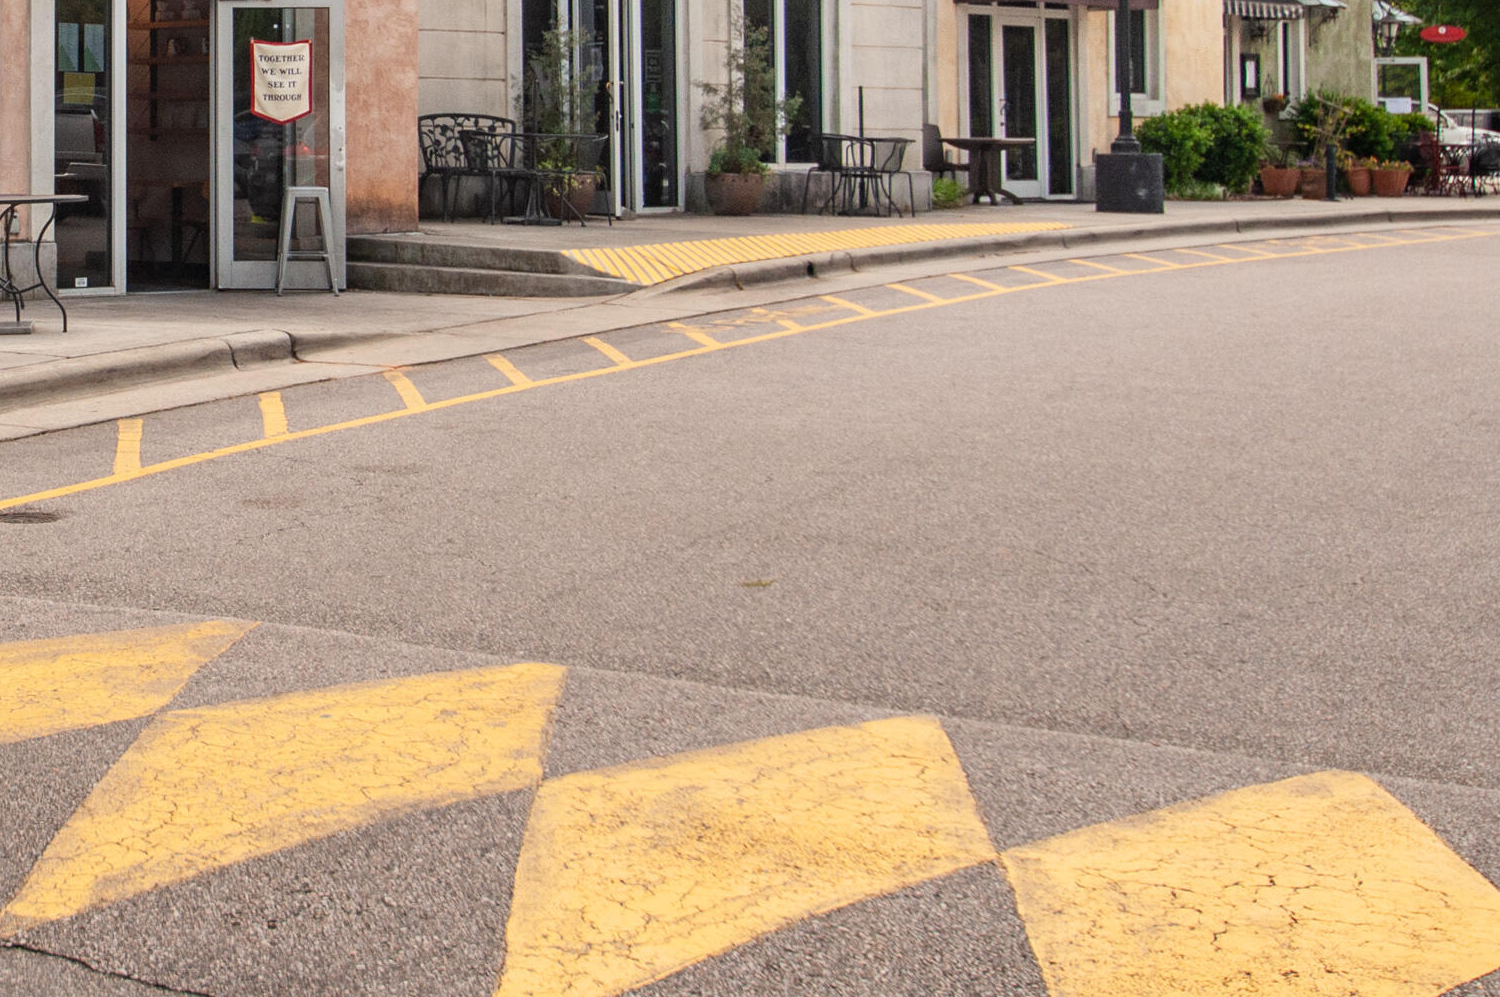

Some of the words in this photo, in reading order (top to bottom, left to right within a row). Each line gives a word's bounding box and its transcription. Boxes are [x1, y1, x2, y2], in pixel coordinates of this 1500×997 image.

[259, 54, 305, 63] TOGETHER
[261, 67, 276, 76] WE
[280, 67, 302, 75] WILL
[267, 81, 285, 89] SEE
[288, 81, 297, 89] IT
[263, 93, 303, 102] THROUGH
